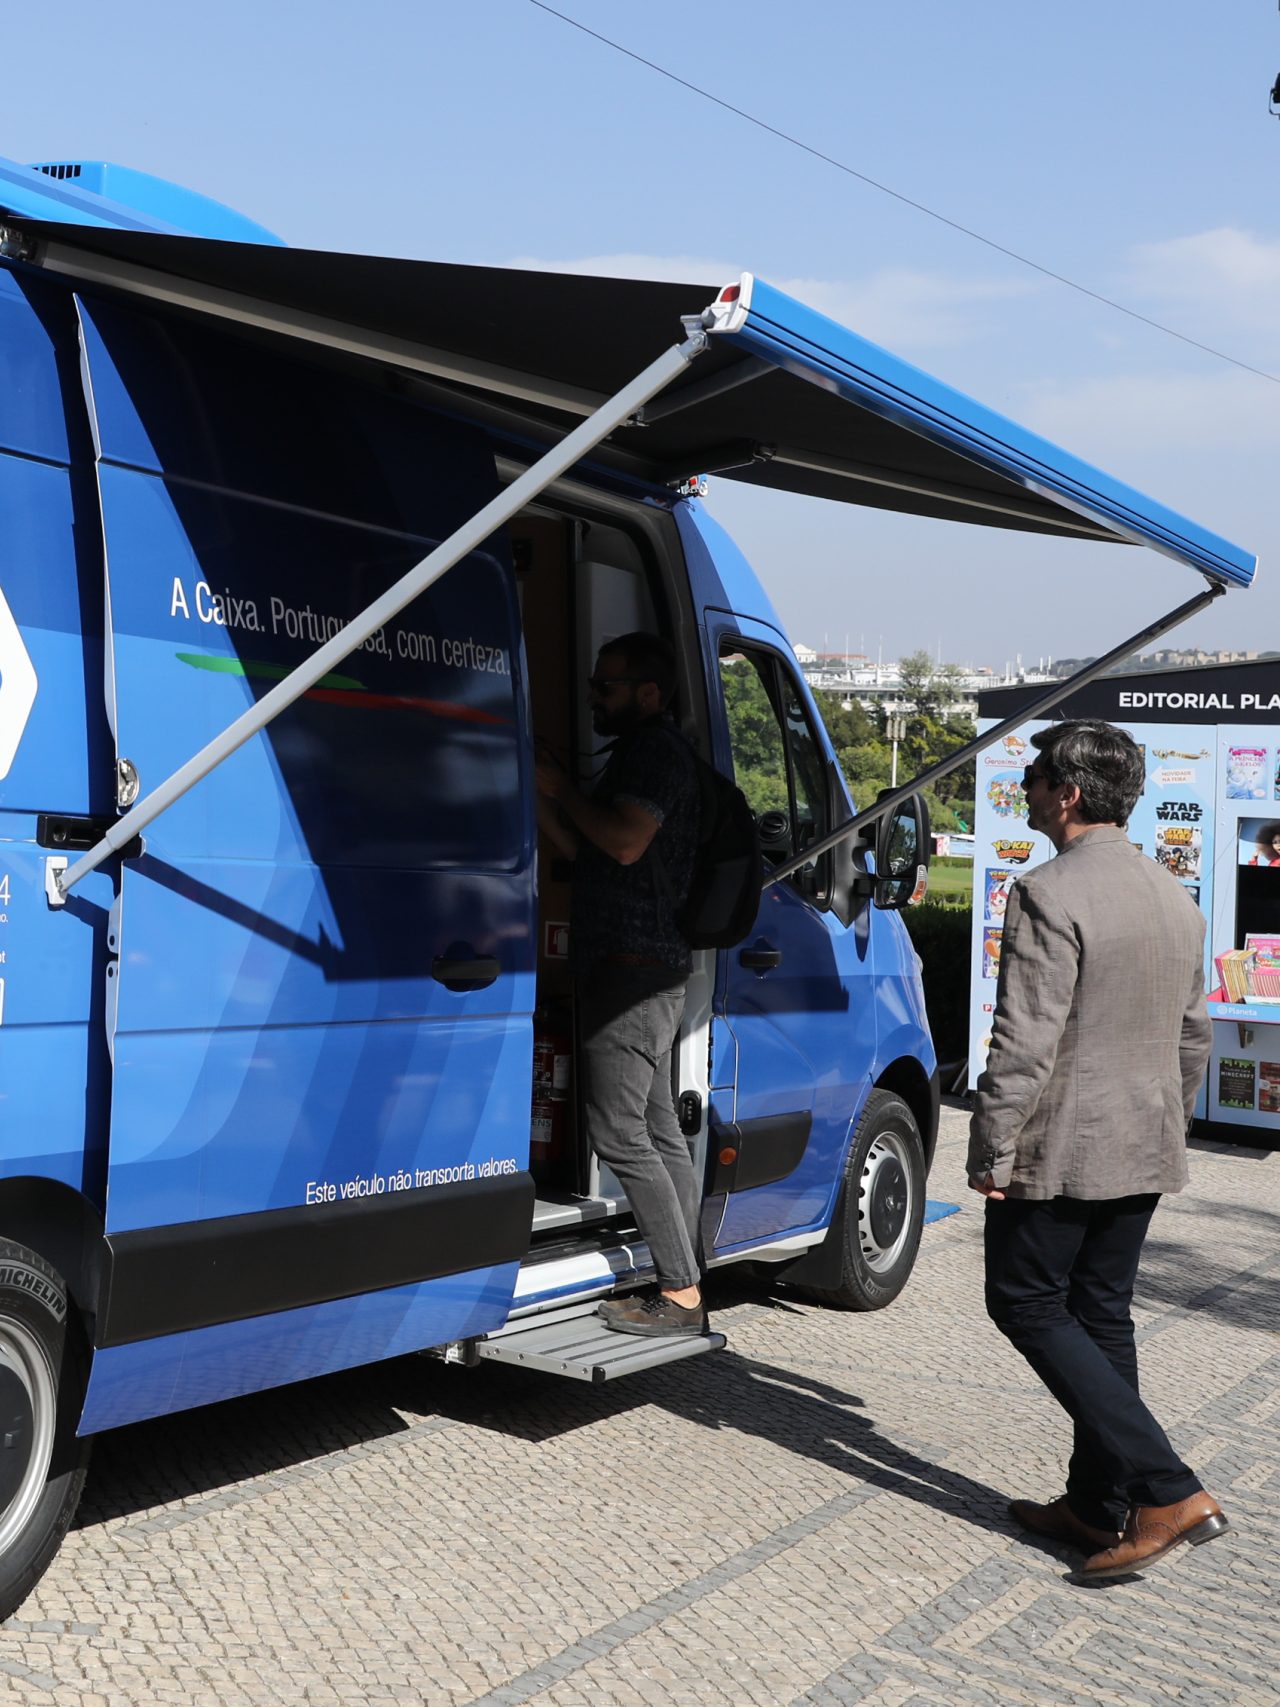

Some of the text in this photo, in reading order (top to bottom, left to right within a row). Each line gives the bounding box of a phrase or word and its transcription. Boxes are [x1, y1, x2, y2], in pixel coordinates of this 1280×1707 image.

[170, 577, 511, 676] A Caixa. Portusa, com certeza.
[1119, 691, 1234, 709] EDITORIAL
[1156, 801, 1203, 813] STAR
[1156, 810, 1203, 822] WARS
[1228, 1007, 1258, 1016] Planeta
[305, 1156, 519, 1205] Este veículo não transporta valores.
